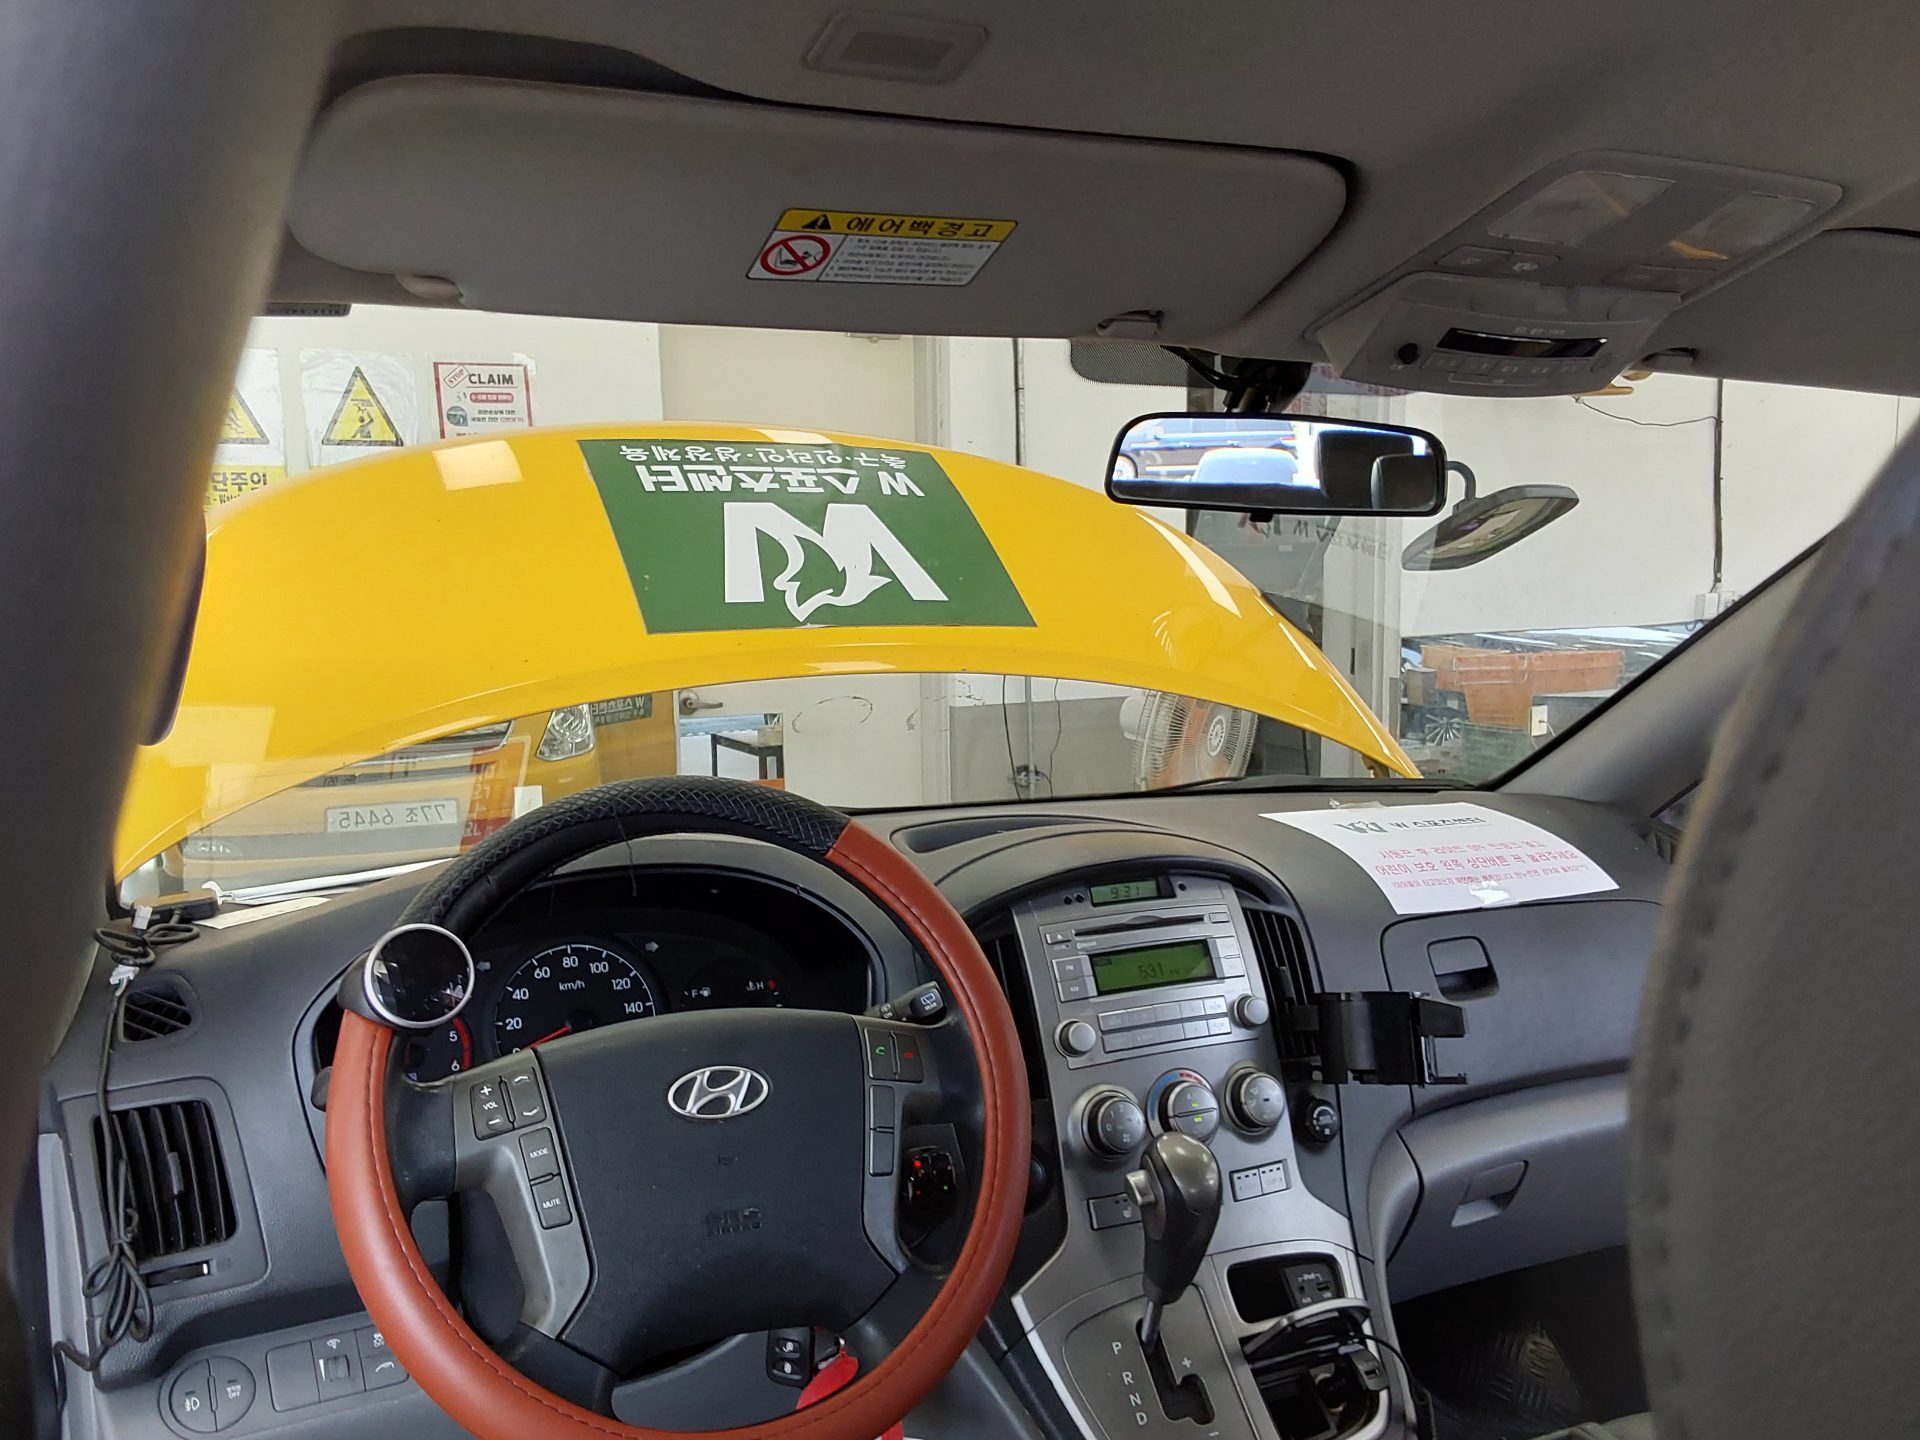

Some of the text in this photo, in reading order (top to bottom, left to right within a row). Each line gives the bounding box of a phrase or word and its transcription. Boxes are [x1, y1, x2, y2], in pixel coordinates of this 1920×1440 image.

[468, 373, 514, 385] CLAIM
[208, 472, 268, 493] 단주의
[635, 463, 925, 497] W 스포츠센터
[1375, 861, 1412, 876] 어린이
[1414, 860, 1439, 873] 보호
[562, 956, 578, 969] 80
[588, 961, 609, 974] 100
[534, 966, 550, 979] 60
[558, 978, 585, 992] km/h
[612, 977, 631, 990] 120
[756, 981, 764, 990] H
[512, 988, 530, 1000] 40
[691, 989, 699, 998] F
[624, 1001, 644, 1014] 140
[505, 1017, 522, 1030] 20
[449, 1031, 458, 1042] 5
[451, 1060, 460, 1071] 6
[482, 1101, 498, 1110] VOL
[529, 1147, 549, 1159] MODE
[542, 1198, 561, 1209] MUTE
[1112, 1341, 1122, 1355] P
[1122, 1371, 1134, 1385] R
[1129, 1392, 1142, 1407] N
[1135, 1412, 1147, 1426] D
